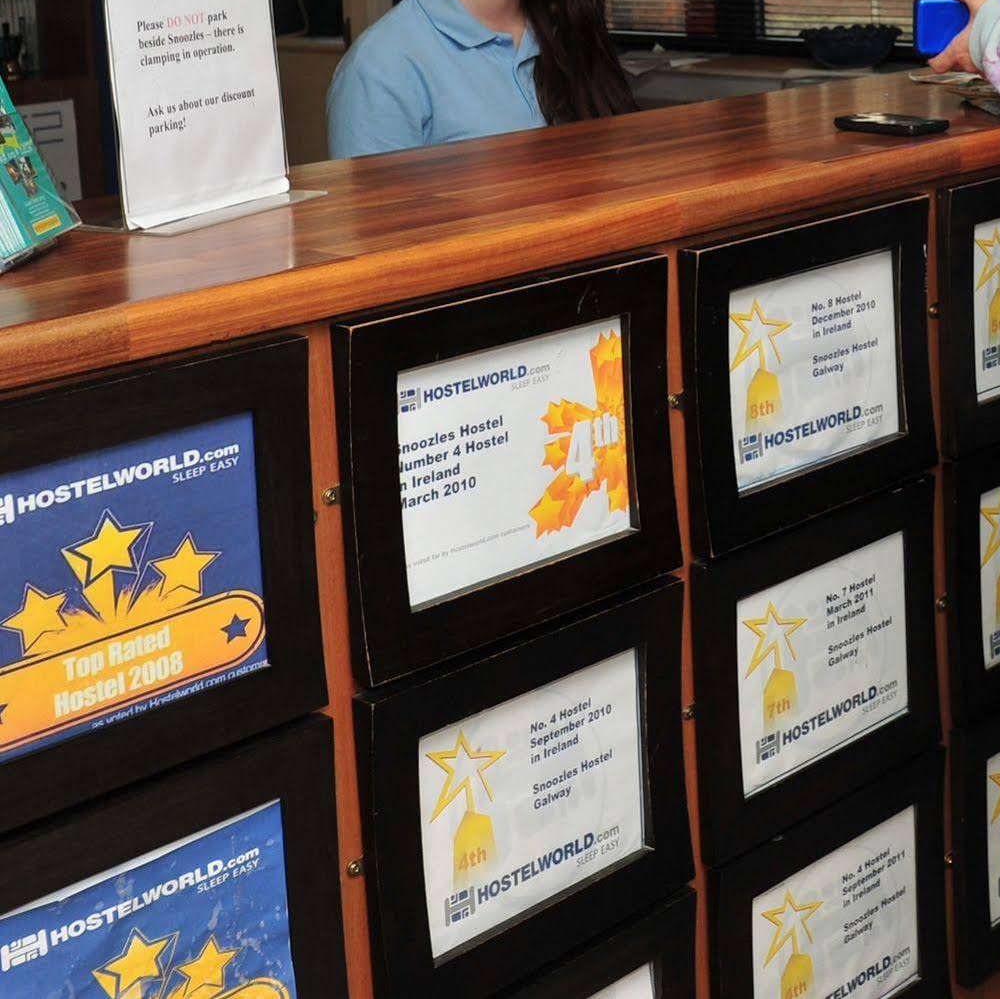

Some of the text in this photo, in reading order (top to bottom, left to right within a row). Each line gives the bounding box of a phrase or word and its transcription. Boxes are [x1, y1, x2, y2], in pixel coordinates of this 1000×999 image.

[137, 10, 228, 33] Please DO NOT park
[138, 35, 166, 50] beside
[168, 30, 205, 44] Snoozles
[213, 27, 235, 40] there
[237, 23, 244, 35] is
[140, 43, 236, 67] clamping in operation.
[147, 88, 255, 119] Ask us about our discount
[148, 116, 187, 138] parking!
[811, 290, 862, 312] No. 8 Hostel
[811, 299, 877, 326] December 2010
[812, 319, 852, 339] in Ireland
[812, 337, 879, 365] Snoozles Hostel
[423, 363, 550, 403] HOSTELWORLD.com
[532, 374, 550, 387] EASY
[812, 361, 845, 379] Galway
[750, 400, 774, 420] 8th
[460, 415, 503, 437] Hostel
[764, 403, 883, 450] HOSTELWORLD.com
[453, 445, 461, 456] 4
[466, 431, 509, 454] Hostel
[17, 443, 240, 515] HOSTELWORLD.com
[172, 455, 240, 485] SLEEP EASY
[412, 463, 461, 488] Ireland
[444, 476, 477, 497] 2010
[826, 574, 876, 604] No. 7 Hostel
[826, 588, 874, 617] March 2011
[827, 605, 866, 630] in Ireland
[827, 616, 893, 655] Snoozles Hostel
[63, 624, 171, 682] Top Rated
[828, 647, 859, 668] Galway
[53, 650, 184, 718] Hostel 2008
[530, 698, 592, 734] No. 4 Hostel
[767, 698, 791, 718] 7th
[782, 679, 897, 747] HOSTELWORLD.com
[530, 703, 612, 750] September 2010
[531, 734, 579, 764] in Ireland
[532, 749, 613, 796] Snoozles Hostel
[533, 785, 571, 811] Galway
[457, 847, 487, 872] 4th
[477, 823, 619, 905] HOSTELWORLD.com
[576, 838, 620, 868] SLEEP EASY
[842, 847, 891, 884] No. 4 Hostel
[197, 859, 260, 894] SLEEP EASY
[842, 864, 885, 897] September
[50, 846, 260, 946] HOSTELWORLD.com
[842, 879, 881, 909] in Ireland
[843, 886, 907, 932] Snoozles Hostel
[843, 921, 874, 945] Galway
